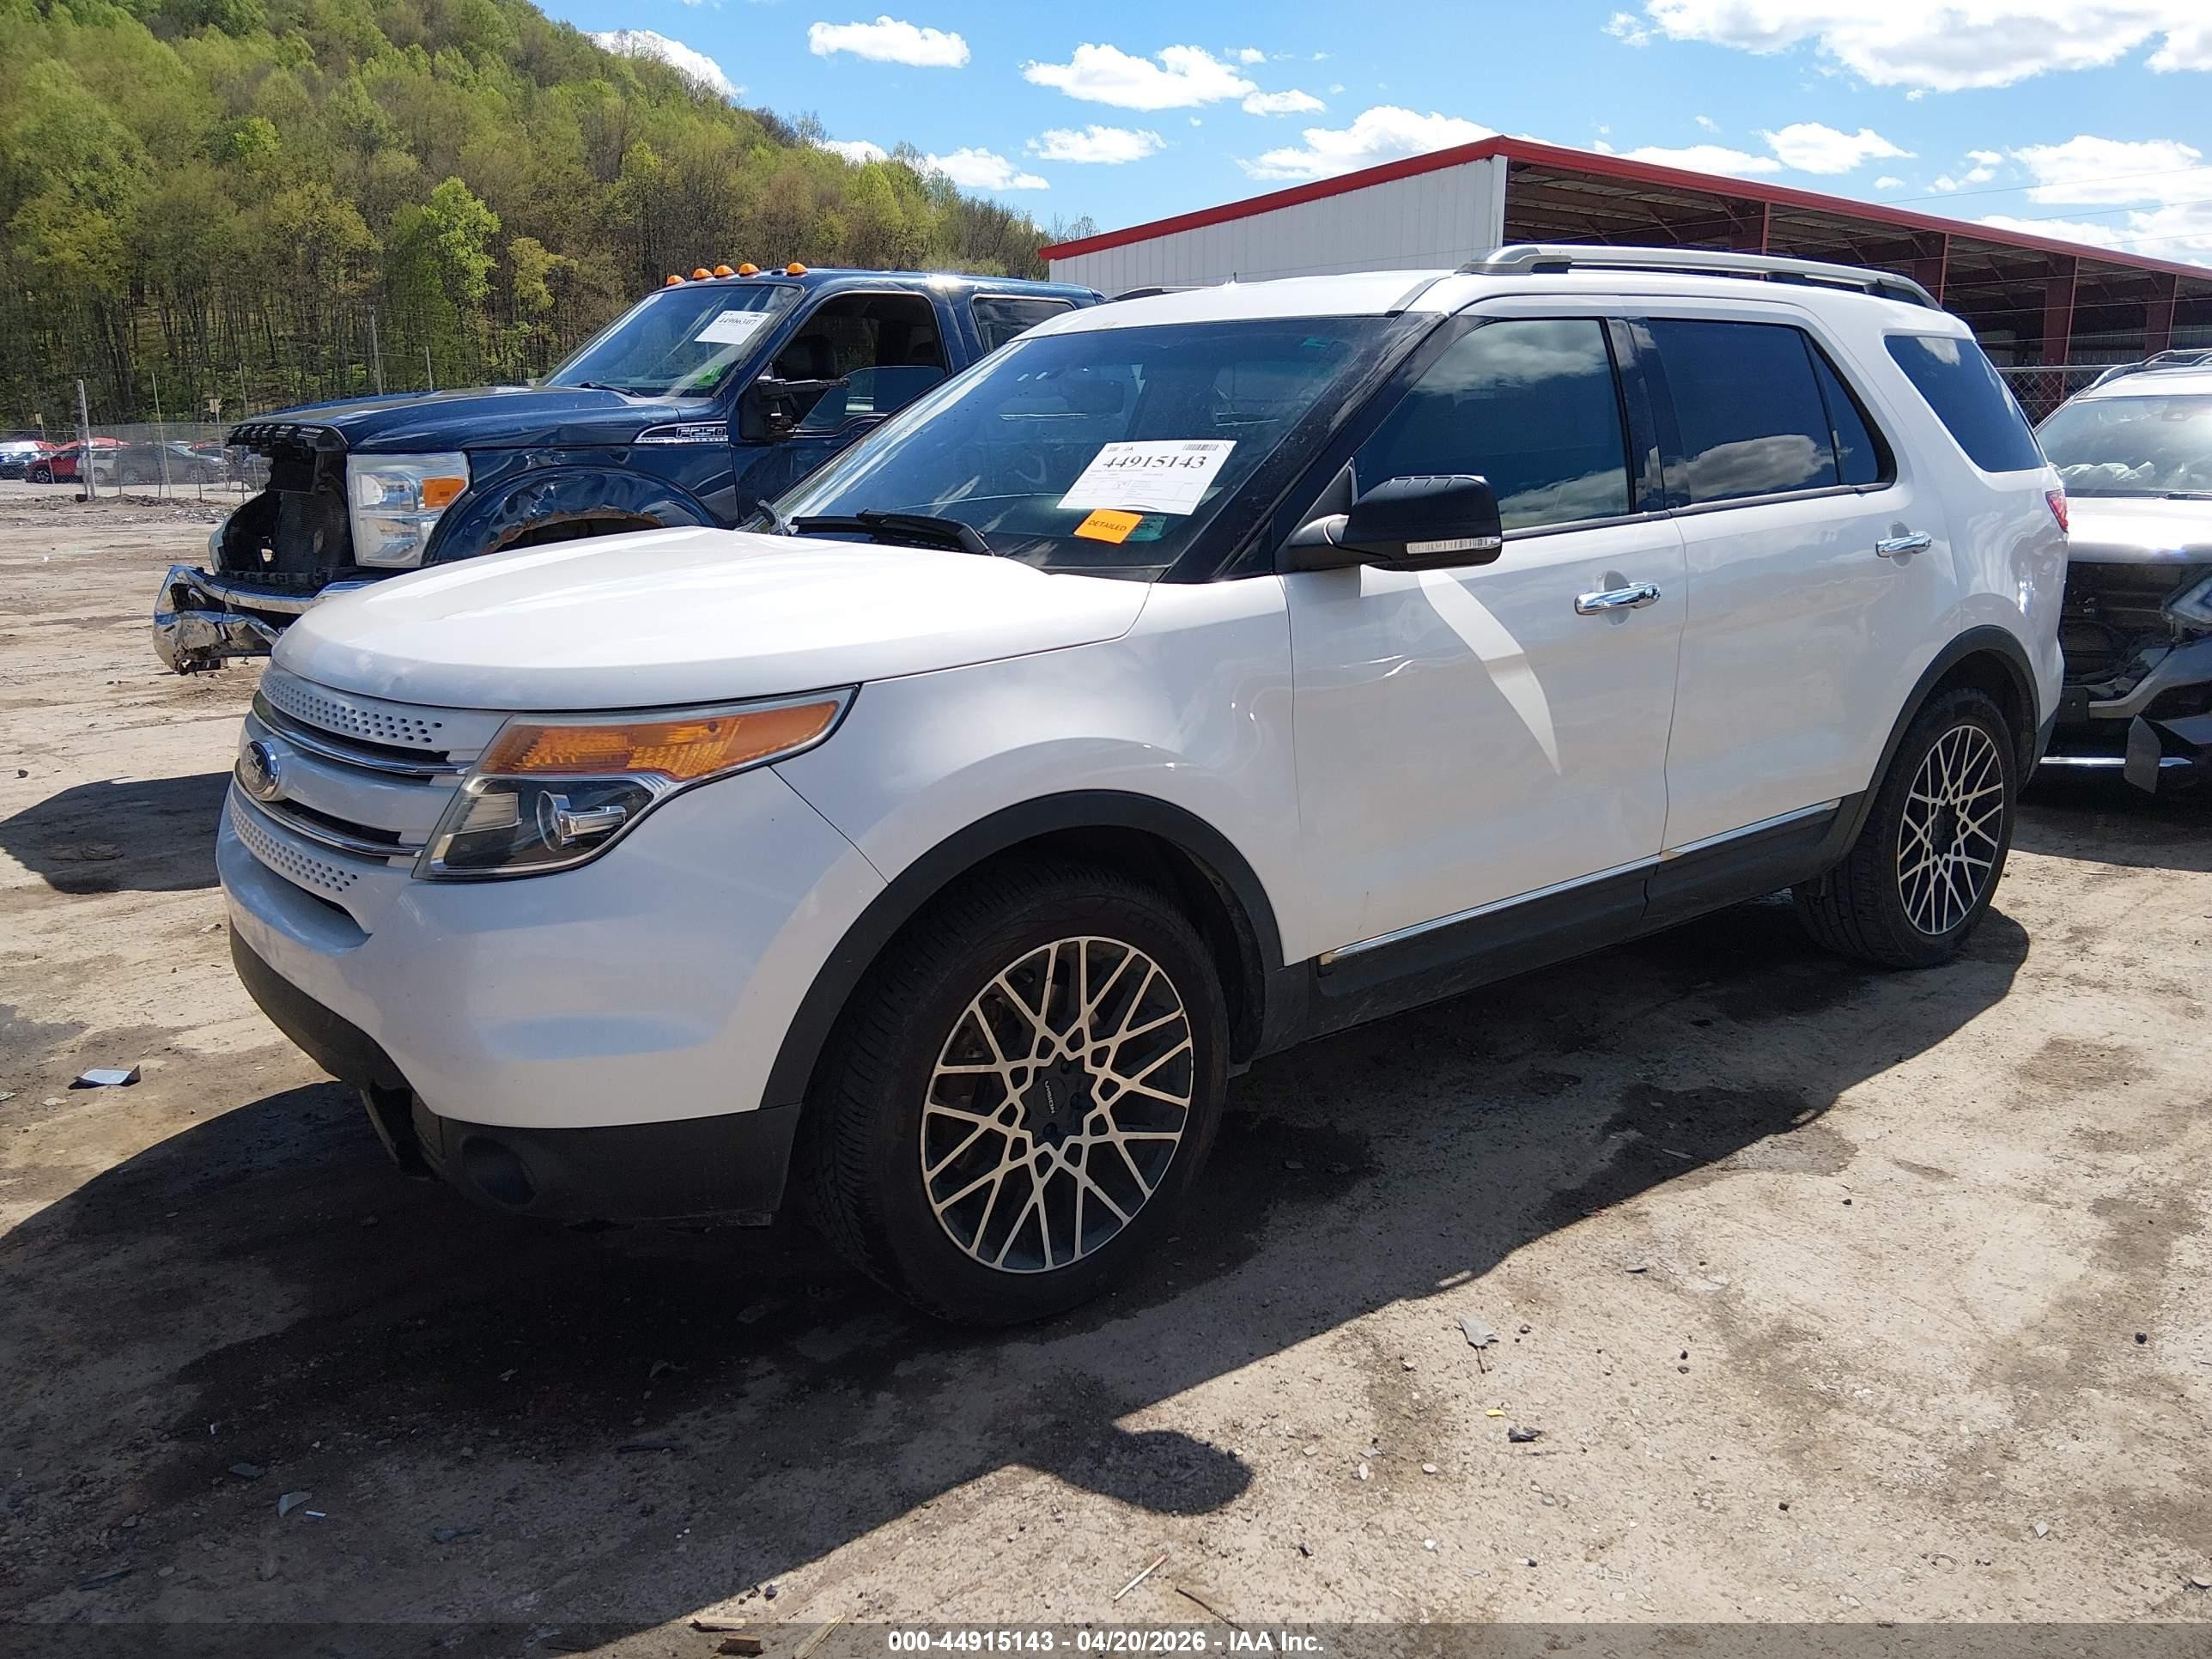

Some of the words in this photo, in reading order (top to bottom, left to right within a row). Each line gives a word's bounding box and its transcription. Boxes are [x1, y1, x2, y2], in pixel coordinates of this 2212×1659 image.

[1103, 455, 1207, 470] 44915143
[1088, 520, 1127, 532] DETAILED
[1045, 1080, 1055, 1114] VISION
